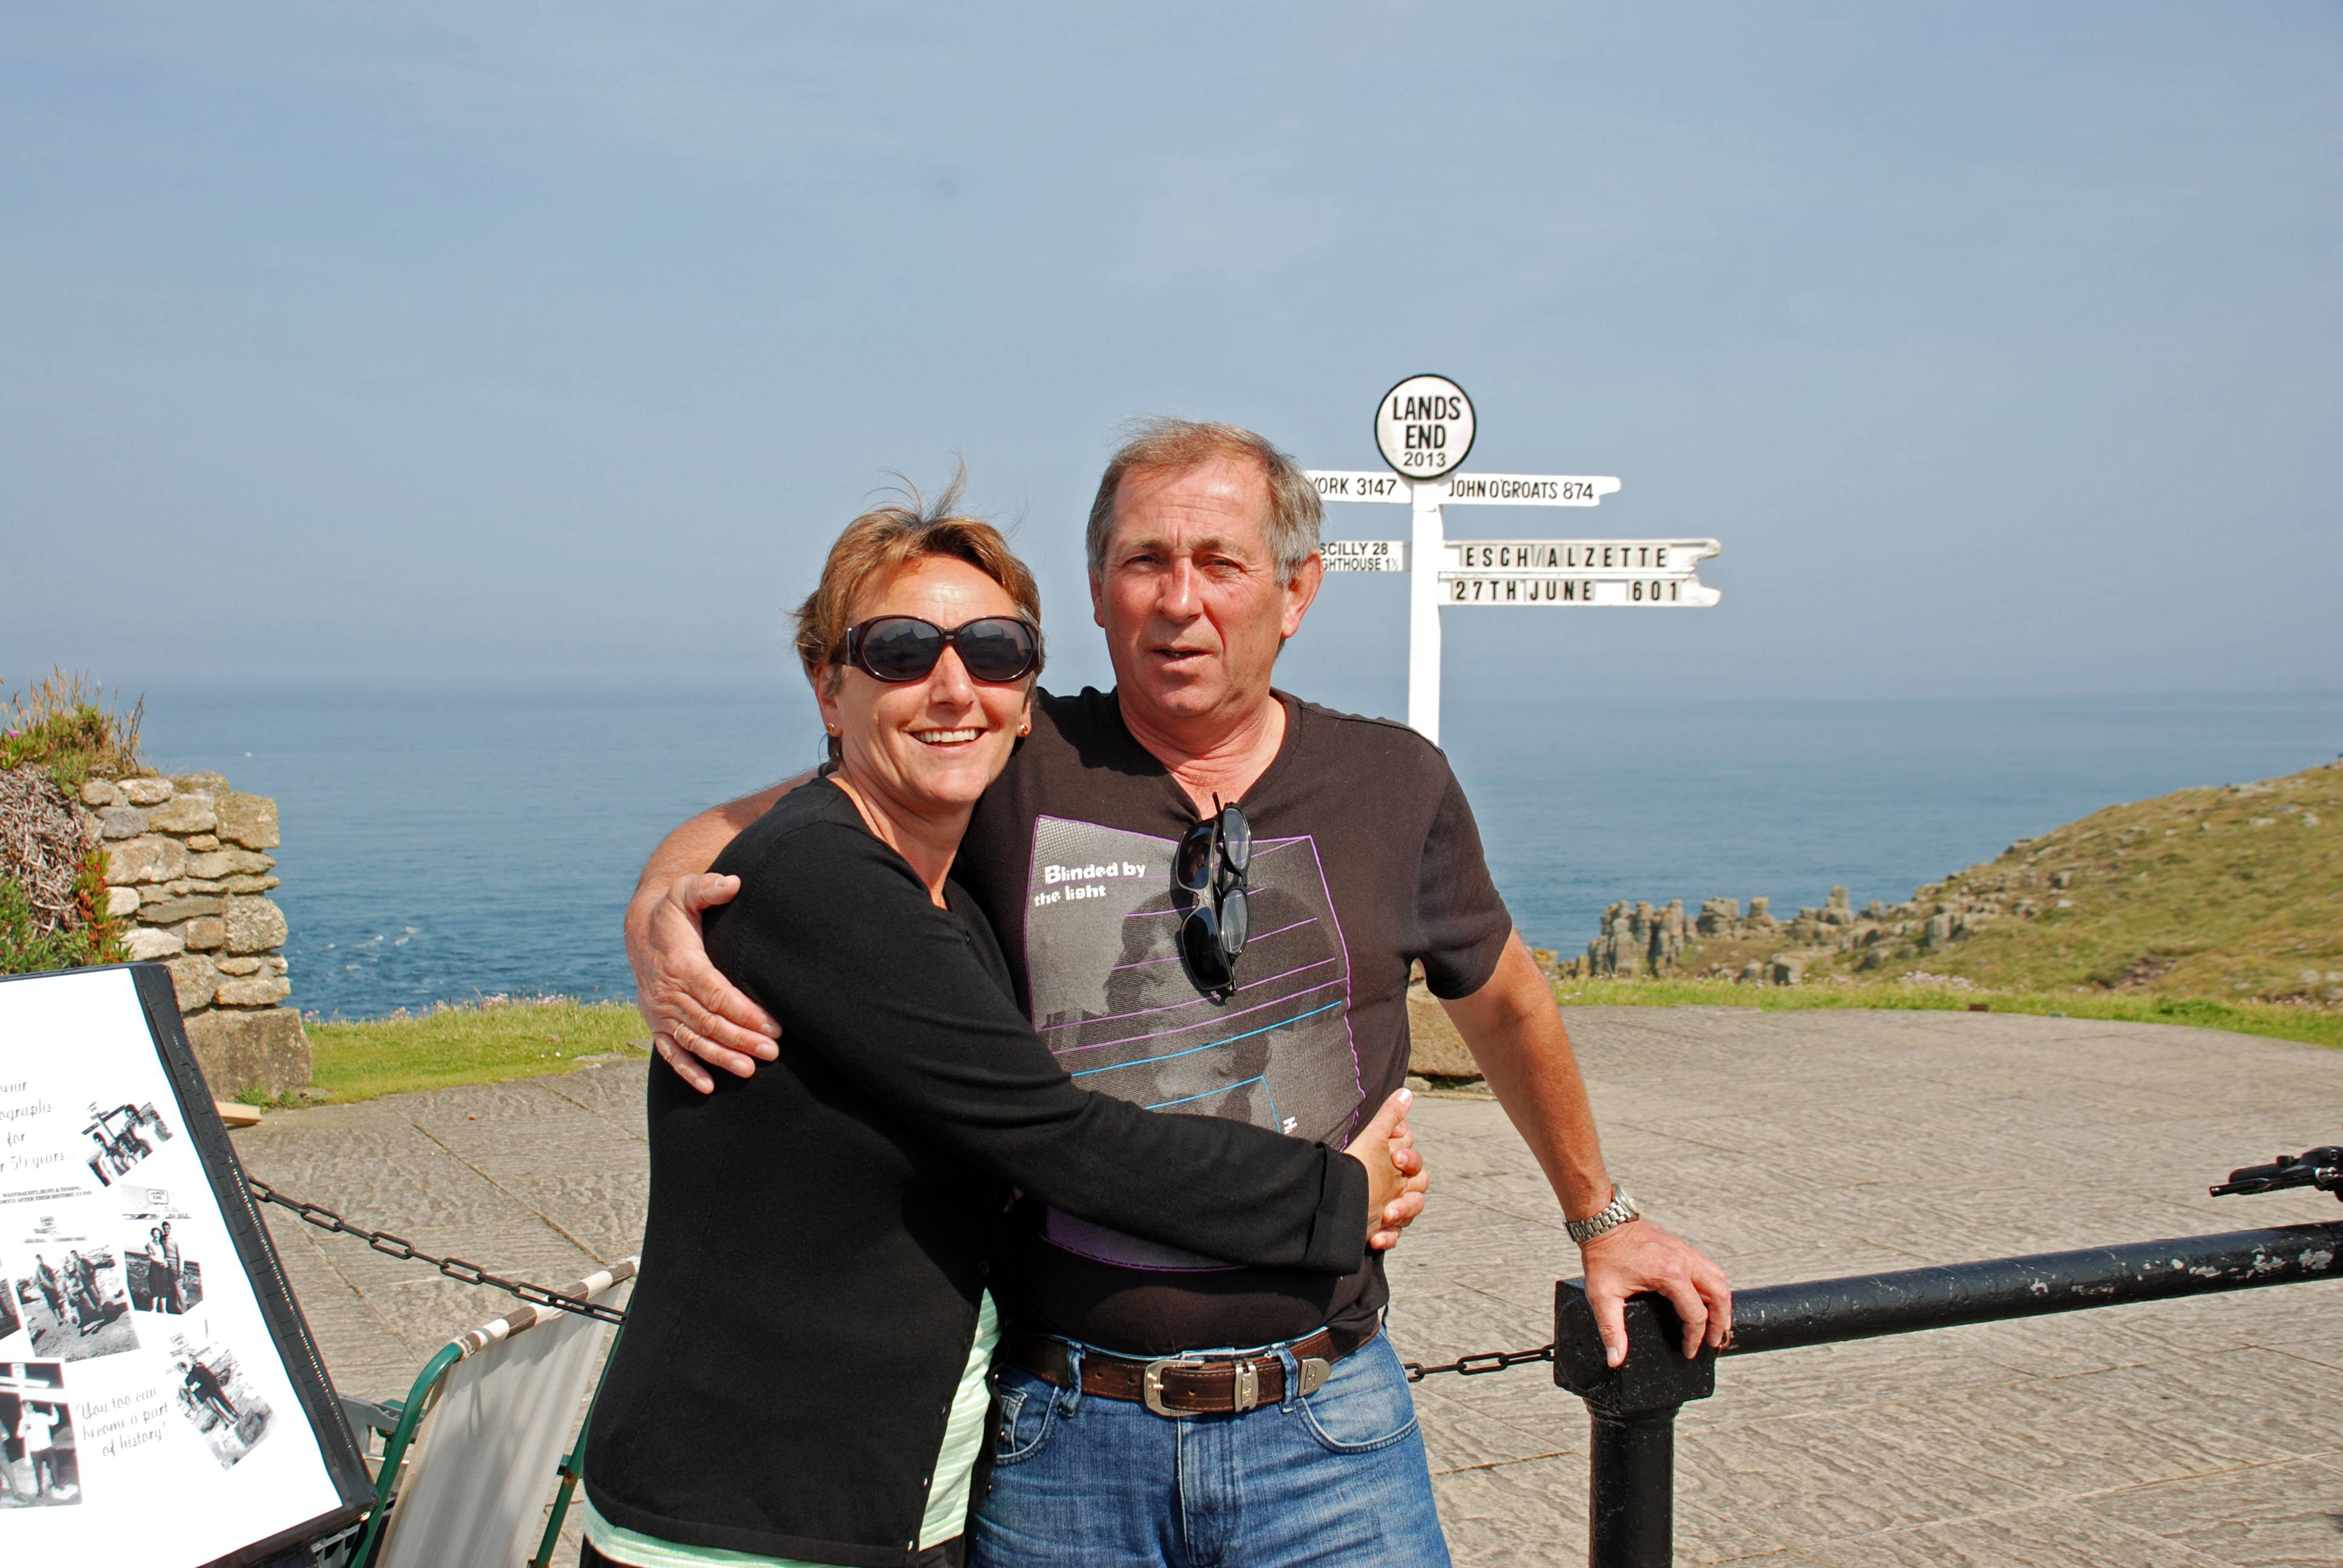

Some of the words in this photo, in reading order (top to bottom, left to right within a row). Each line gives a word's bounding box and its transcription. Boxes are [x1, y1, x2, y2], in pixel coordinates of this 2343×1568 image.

[1393, 396, 1461, 420] LANDS
[1405, 424, 1446, 449] END
[1403, 451, 1446, 467] 2013
[1357, 477, 1397, 495] 3147
[1448, 479, 1486, 497] JOHN
[1563, 482, 1594, 500] 874
[1320, 543, 1368, 555] SCILLY
[1373, 543, 1388, 555] 28
[1466, 547, 1667, 567] ESCH/ALZETTE
[1456, 581, 1516, 600] 27TH
[1530, 581, 1591, 601] JUNE
[1633, 581, 1677, 601] 601
[1044, 862, 1118, 884] Blinded
[1122, 861, 1145, 878] by
[1034, 890, 1061, 907] the
[1065, 884, 1106, 900] light
[7, 1130, 25, 1148] for
[11, 1155, 28, 1170] 50
[76, 1402, 110, 1422] You
[113, 1396, 131, 1409] too
[136, 1388, 158, 1402] can
[83, 1419, 126, 1440] become
[131, 1415, 139, 1425] a
[143, 1402, 169, 1424] part
[103, 1438, 117, 1457] of
